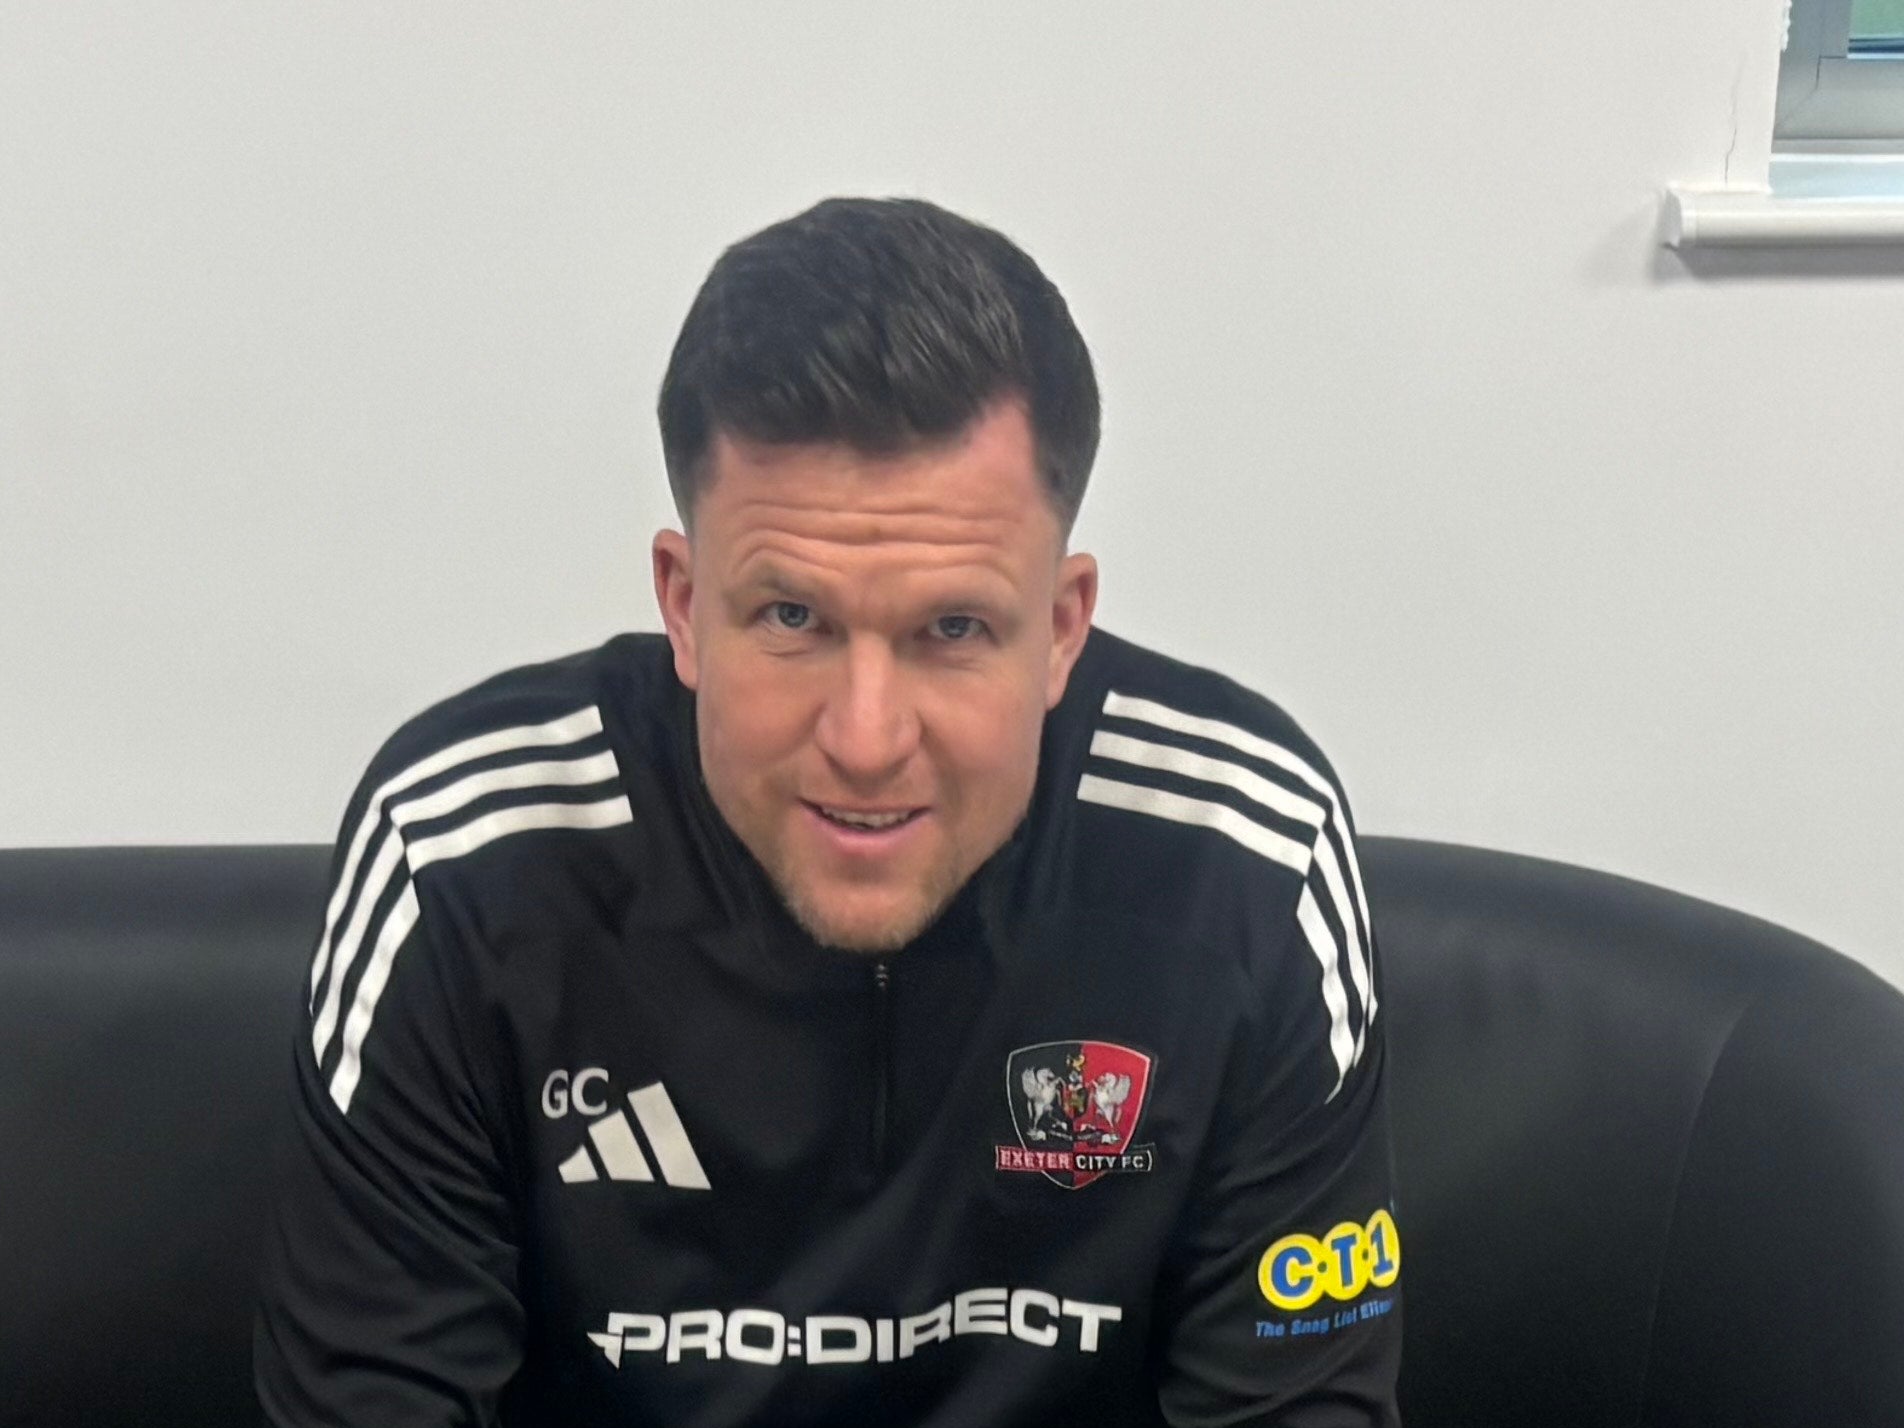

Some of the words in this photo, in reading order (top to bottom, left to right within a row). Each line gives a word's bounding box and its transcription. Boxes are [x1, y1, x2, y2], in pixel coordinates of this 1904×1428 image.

[542, 1067, 610, 1120] GC
[1000, 1150, 1070, 1170] EXETER
[1076, 1154, 1116, 1170] CITY
[1122, 1154, 1144, 1169] FC
[588, 1286, 1122, 1368] PRO:DIRECT
[1256, 1320, 1286, 1338] The
